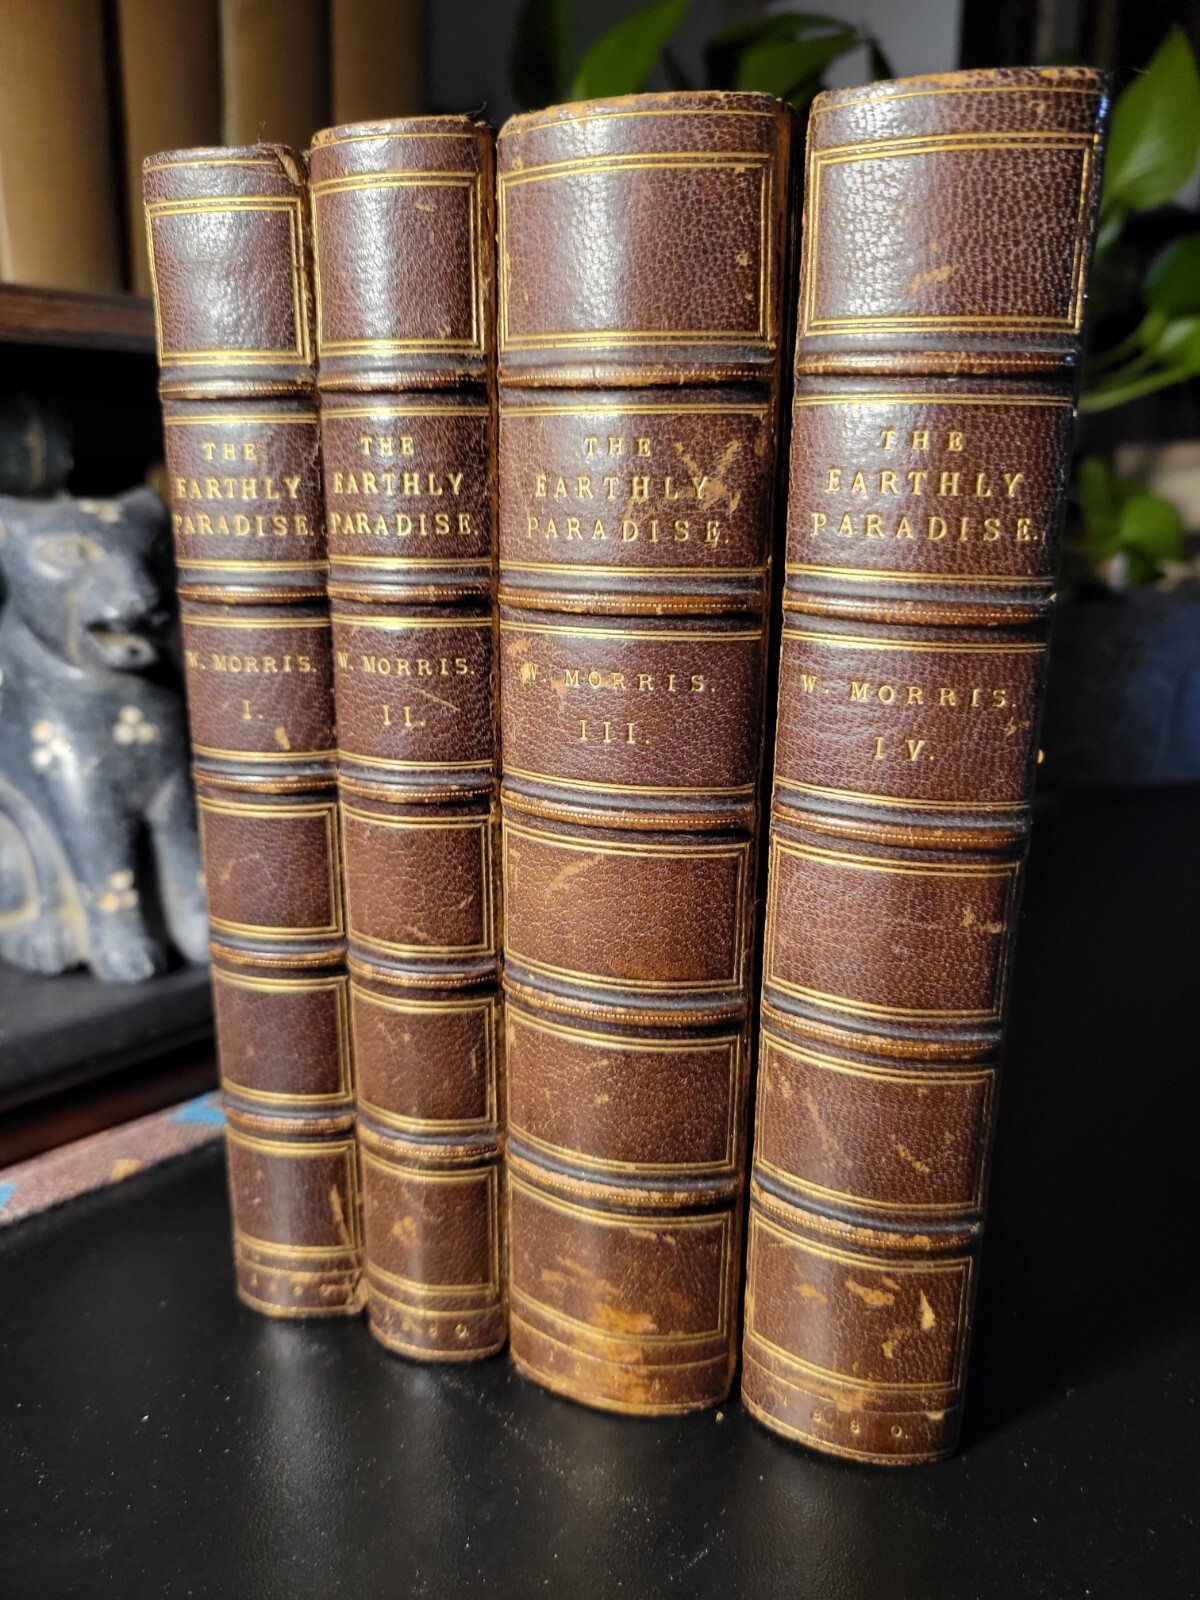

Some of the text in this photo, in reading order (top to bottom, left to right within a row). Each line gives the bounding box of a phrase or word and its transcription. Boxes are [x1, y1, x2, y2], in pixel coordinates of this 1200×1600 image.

[203, 441, 257, 461] THE
[360, 436, 414, 456] THE
[584, 437, 652, 457] THE
[881, 430, 964, 451] THE
[175, 476, 302, 500] EARTHLY
[333, 472, 463, 496] EARTHLY
[535, 474, 709, 500] EARTHLY
[825, 467, 1023, 497] EARTHLY
[172, 512, 315, 537] PARADISE.
[330, 511, 479, 536] PARADISE.
[527, 516, 730, 544] PARADISE.
[810, 512, 1038, 542] PARADISE.
[184, 650, 318, 673] W. MORRIS.
[337, 652, 475, 676] W. MORRIS.
[564, 668, 716, 692] MORRIS.
[801, 674, 1018, 708] W. MORRIS.
